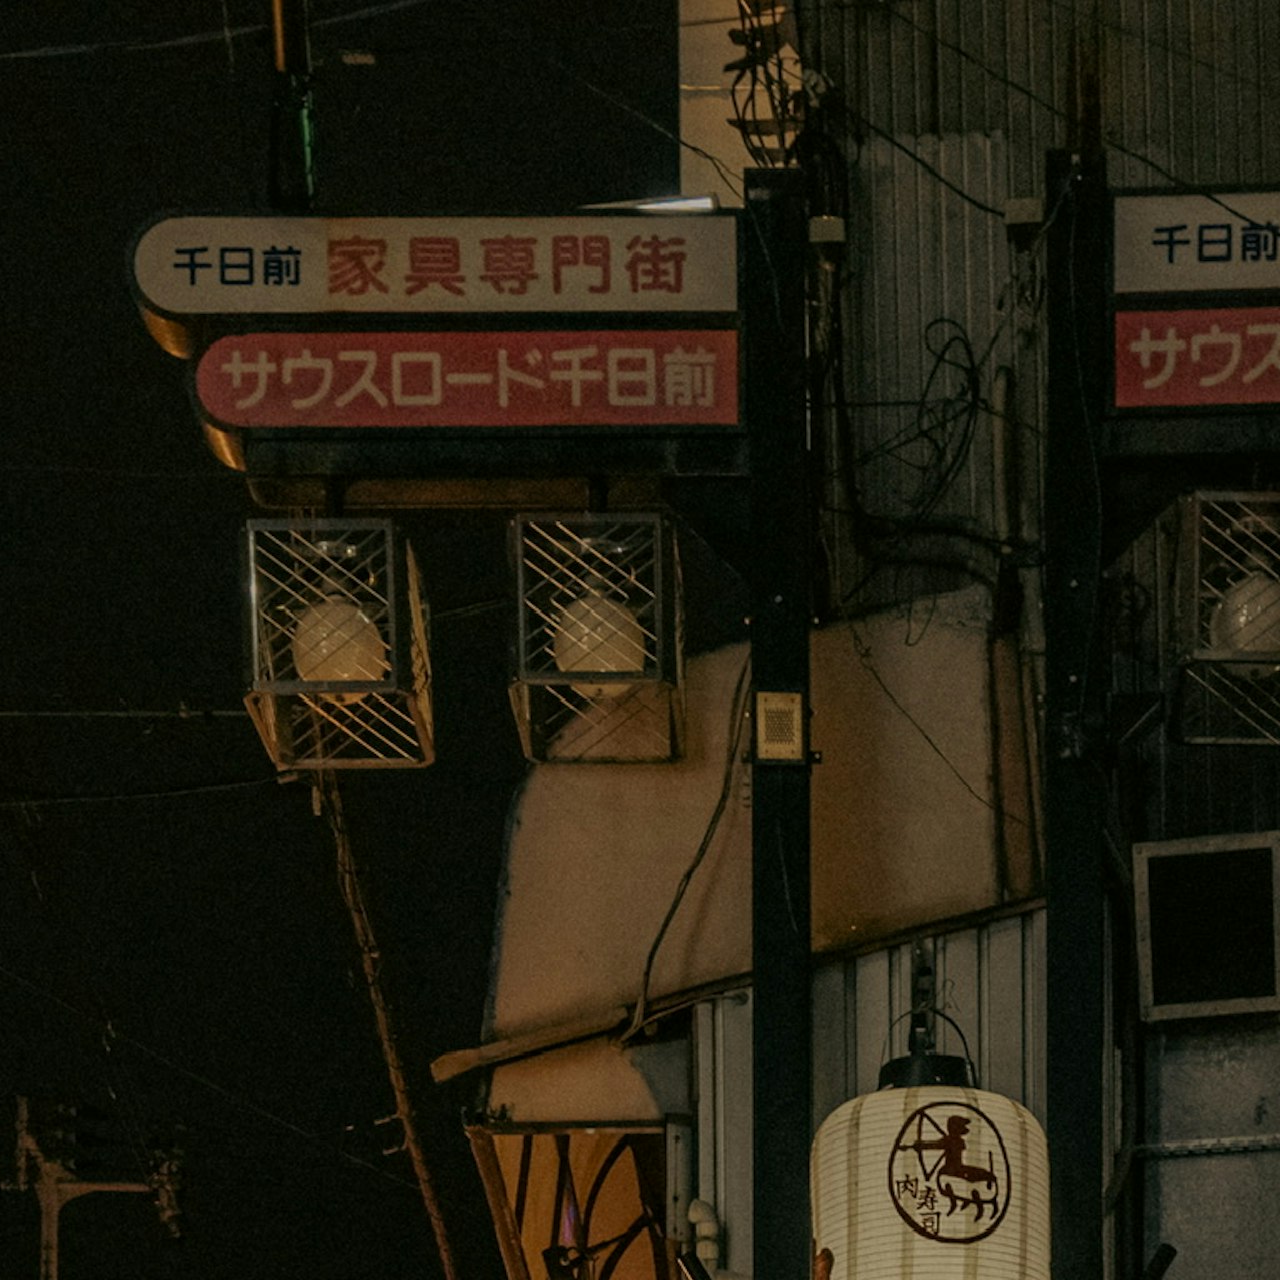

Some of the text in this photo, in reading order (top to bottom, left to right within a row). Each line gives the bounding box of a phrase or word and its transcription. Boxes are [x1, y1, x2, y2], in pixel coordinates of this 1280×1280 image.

[173, 235, 687, 296] 千日前 家具専門街
[1151, 223, 1280, 264] 千日前
[220, 346, 717, 410] サウスロード千日前
[896, 1174, 940, 1237] 肉寿司
